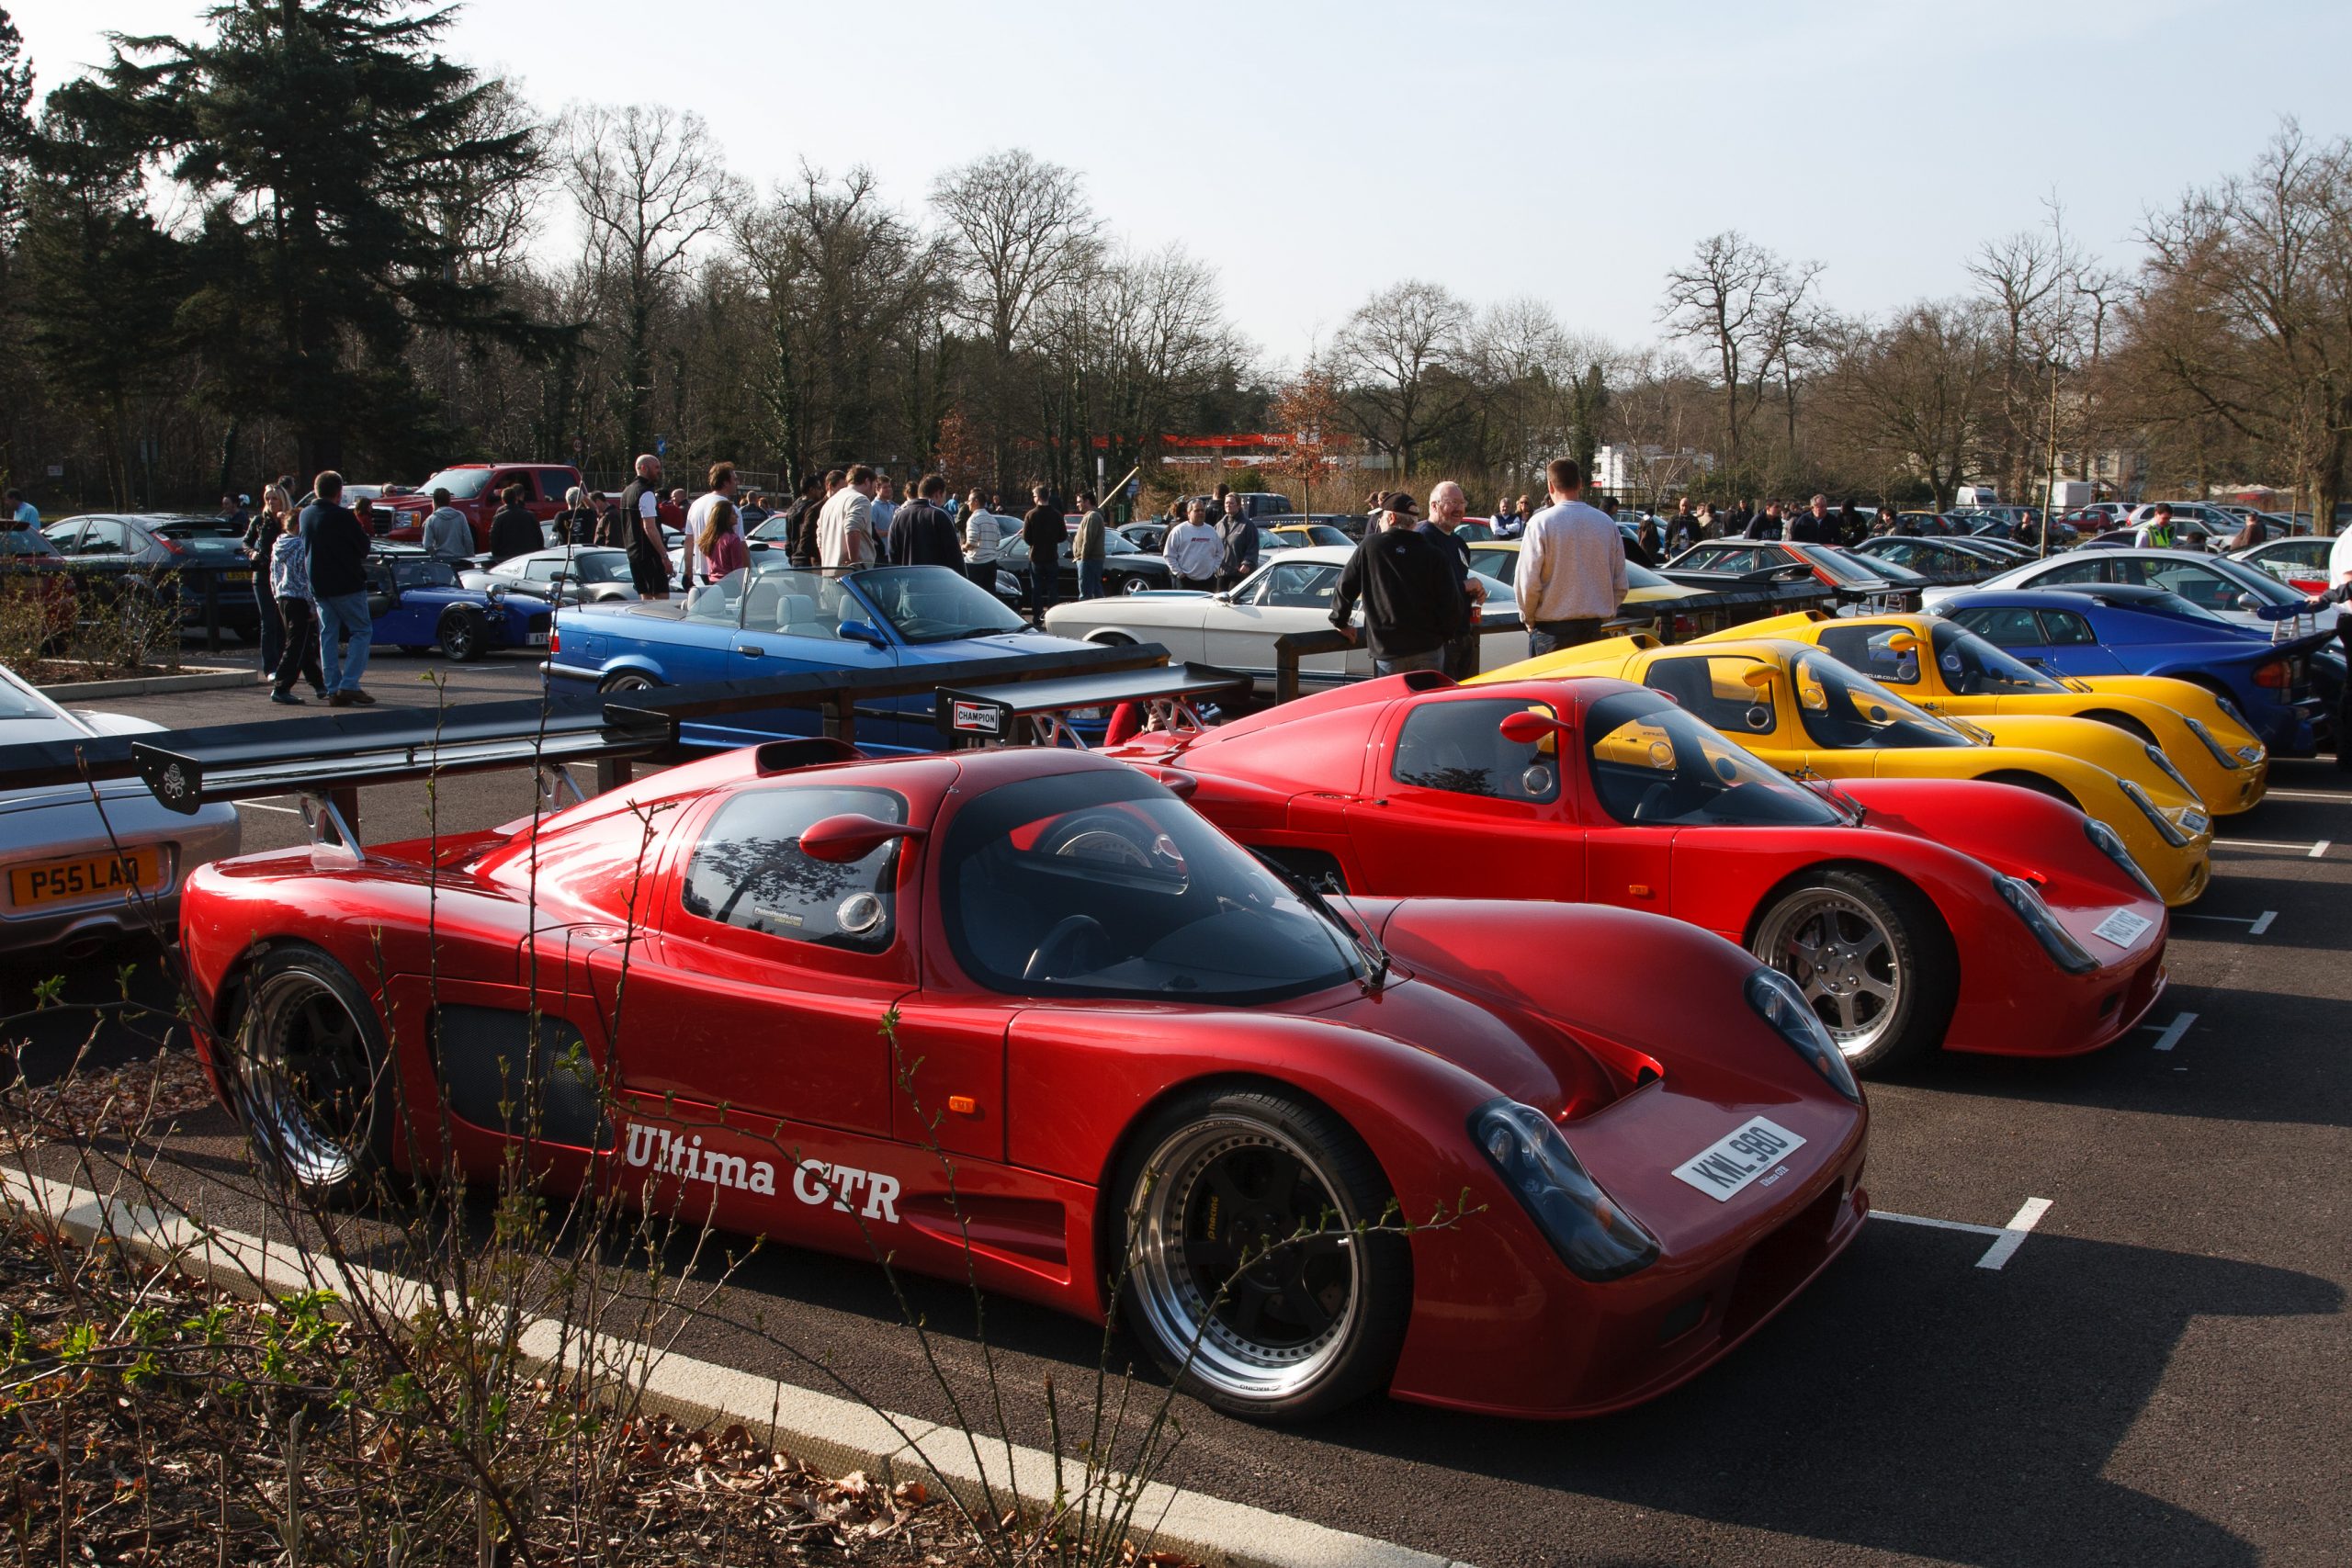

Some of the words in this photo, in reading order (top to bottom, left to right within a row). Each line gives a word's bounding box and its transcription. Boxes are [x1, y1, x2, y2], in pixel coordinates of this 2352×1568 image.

[958, 711, 995, 723] CHAMPION
[30, 865, 84, 898] P55
[626, 1122, 775, 1196] Ultima
[793, 1158, 901, 1224] GTR
[1691, 1152, 1758, 1190] KWL
[1729, 1126, 1789, 1163] 980
